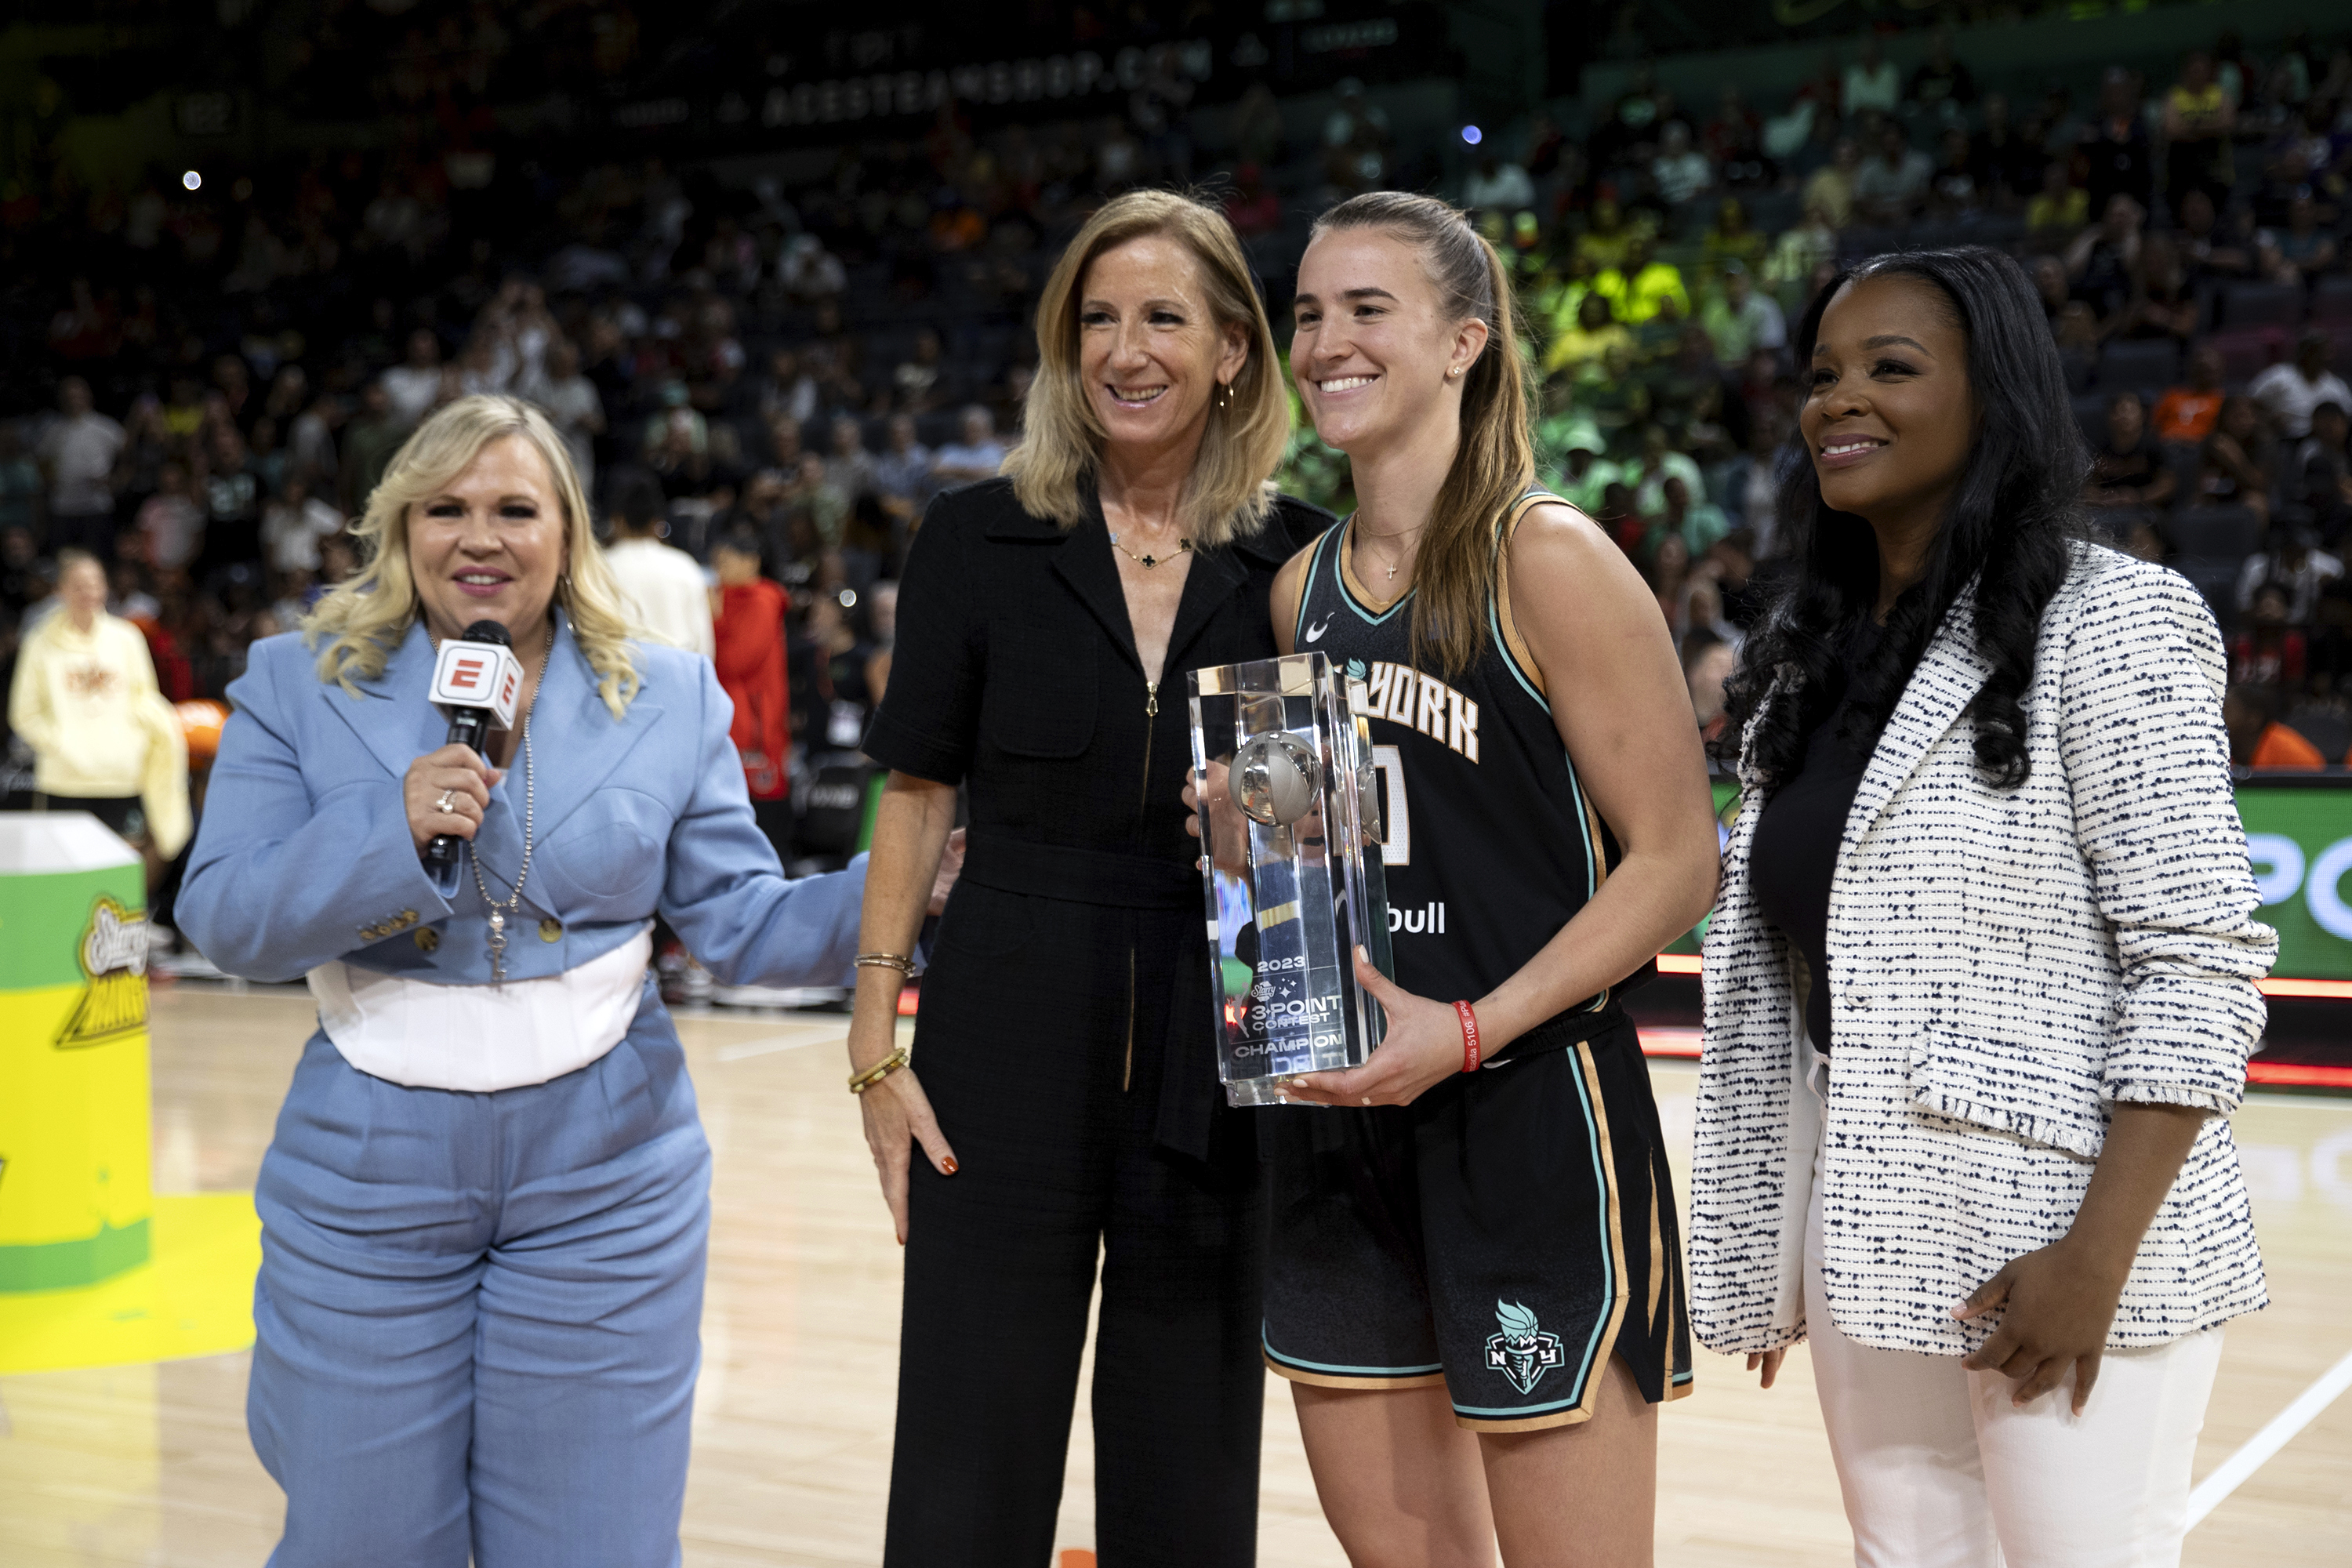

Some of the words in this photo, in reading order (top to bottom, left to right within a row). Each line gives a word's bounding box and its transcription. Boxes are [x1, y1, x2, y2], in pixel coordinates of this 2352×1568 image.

[1368, 662, 1479, 765] YORK
[1386, 902, 1445, 934] bull
[1257, 956, 1305, 973] 2023
[1250, 983, 1276, 998] Starry
[1252, 1012, 1330, 1031] CONTEST
[1465, 1021, 1477, 1047] 5106
[1235, 1033, 1343, 1058] CHAMPION
[1490, 1351, 1507, 1365] N
